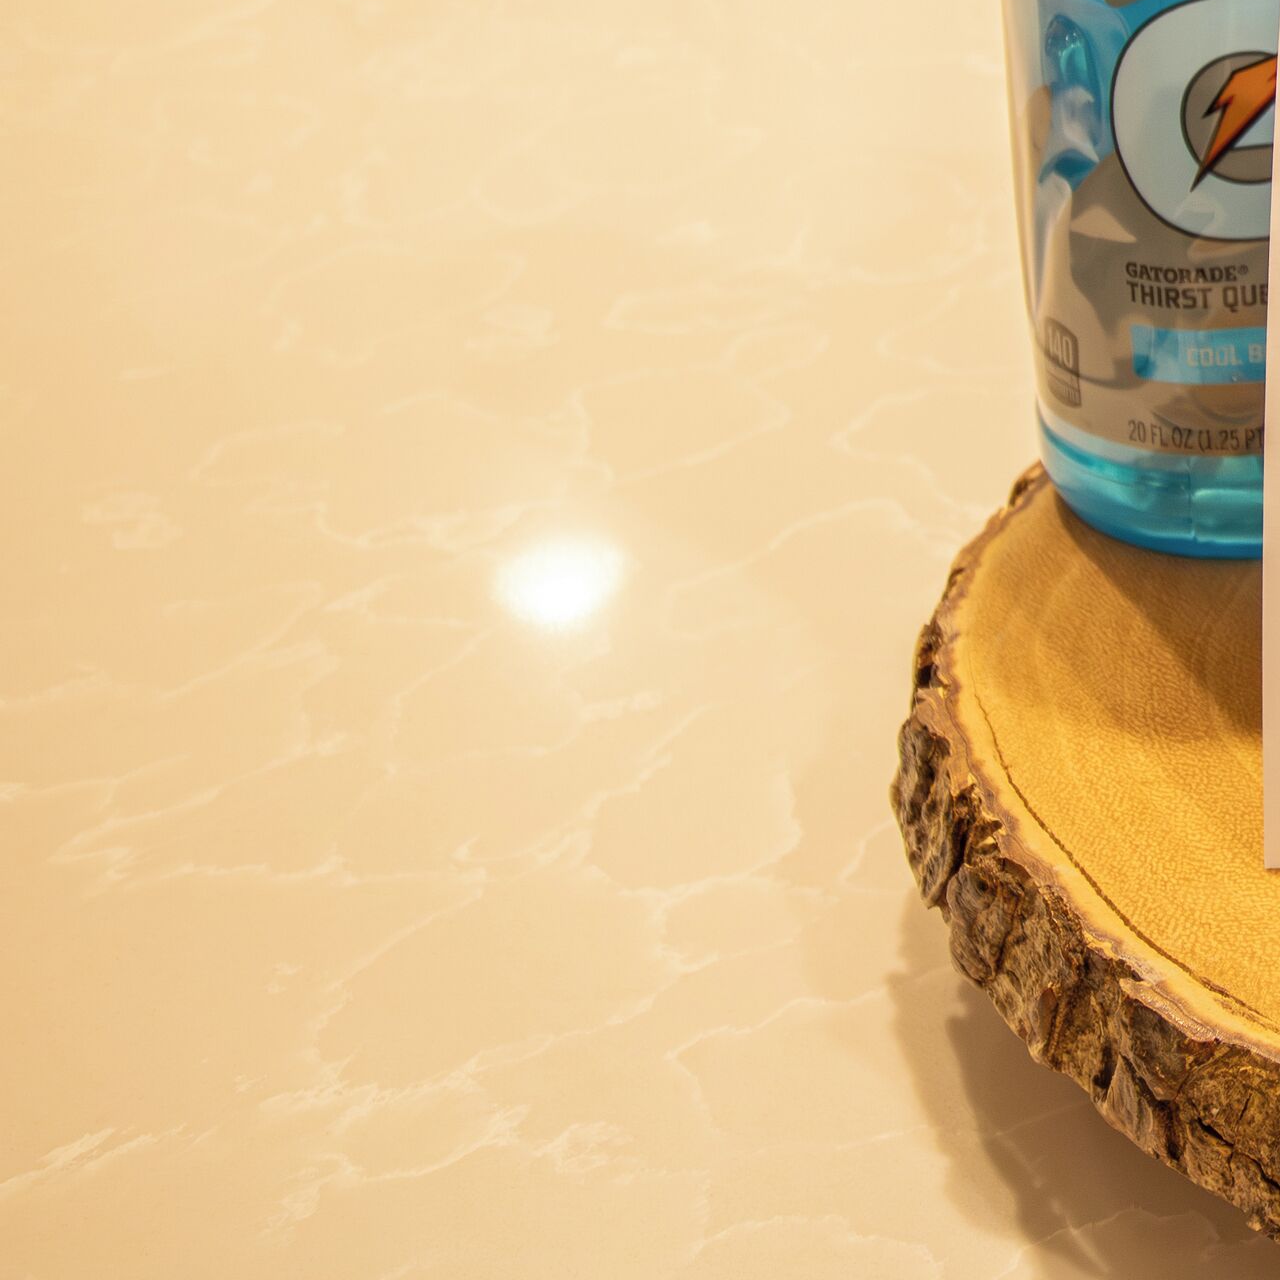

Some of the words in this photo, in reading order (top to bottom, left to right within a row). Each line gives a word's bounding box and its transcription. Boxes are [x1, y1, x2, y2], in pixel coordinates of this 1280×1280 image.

[1126, 280, 1213, 310] THIRST
[1186, 343, 1243, 368] COOL
[1127, 419, 1147, 443] 20
[1151, 423, 1168, 448] FL
[1171, 426, 1194, 449] OZ
[1198, 427, 1240, 453] (1.25
